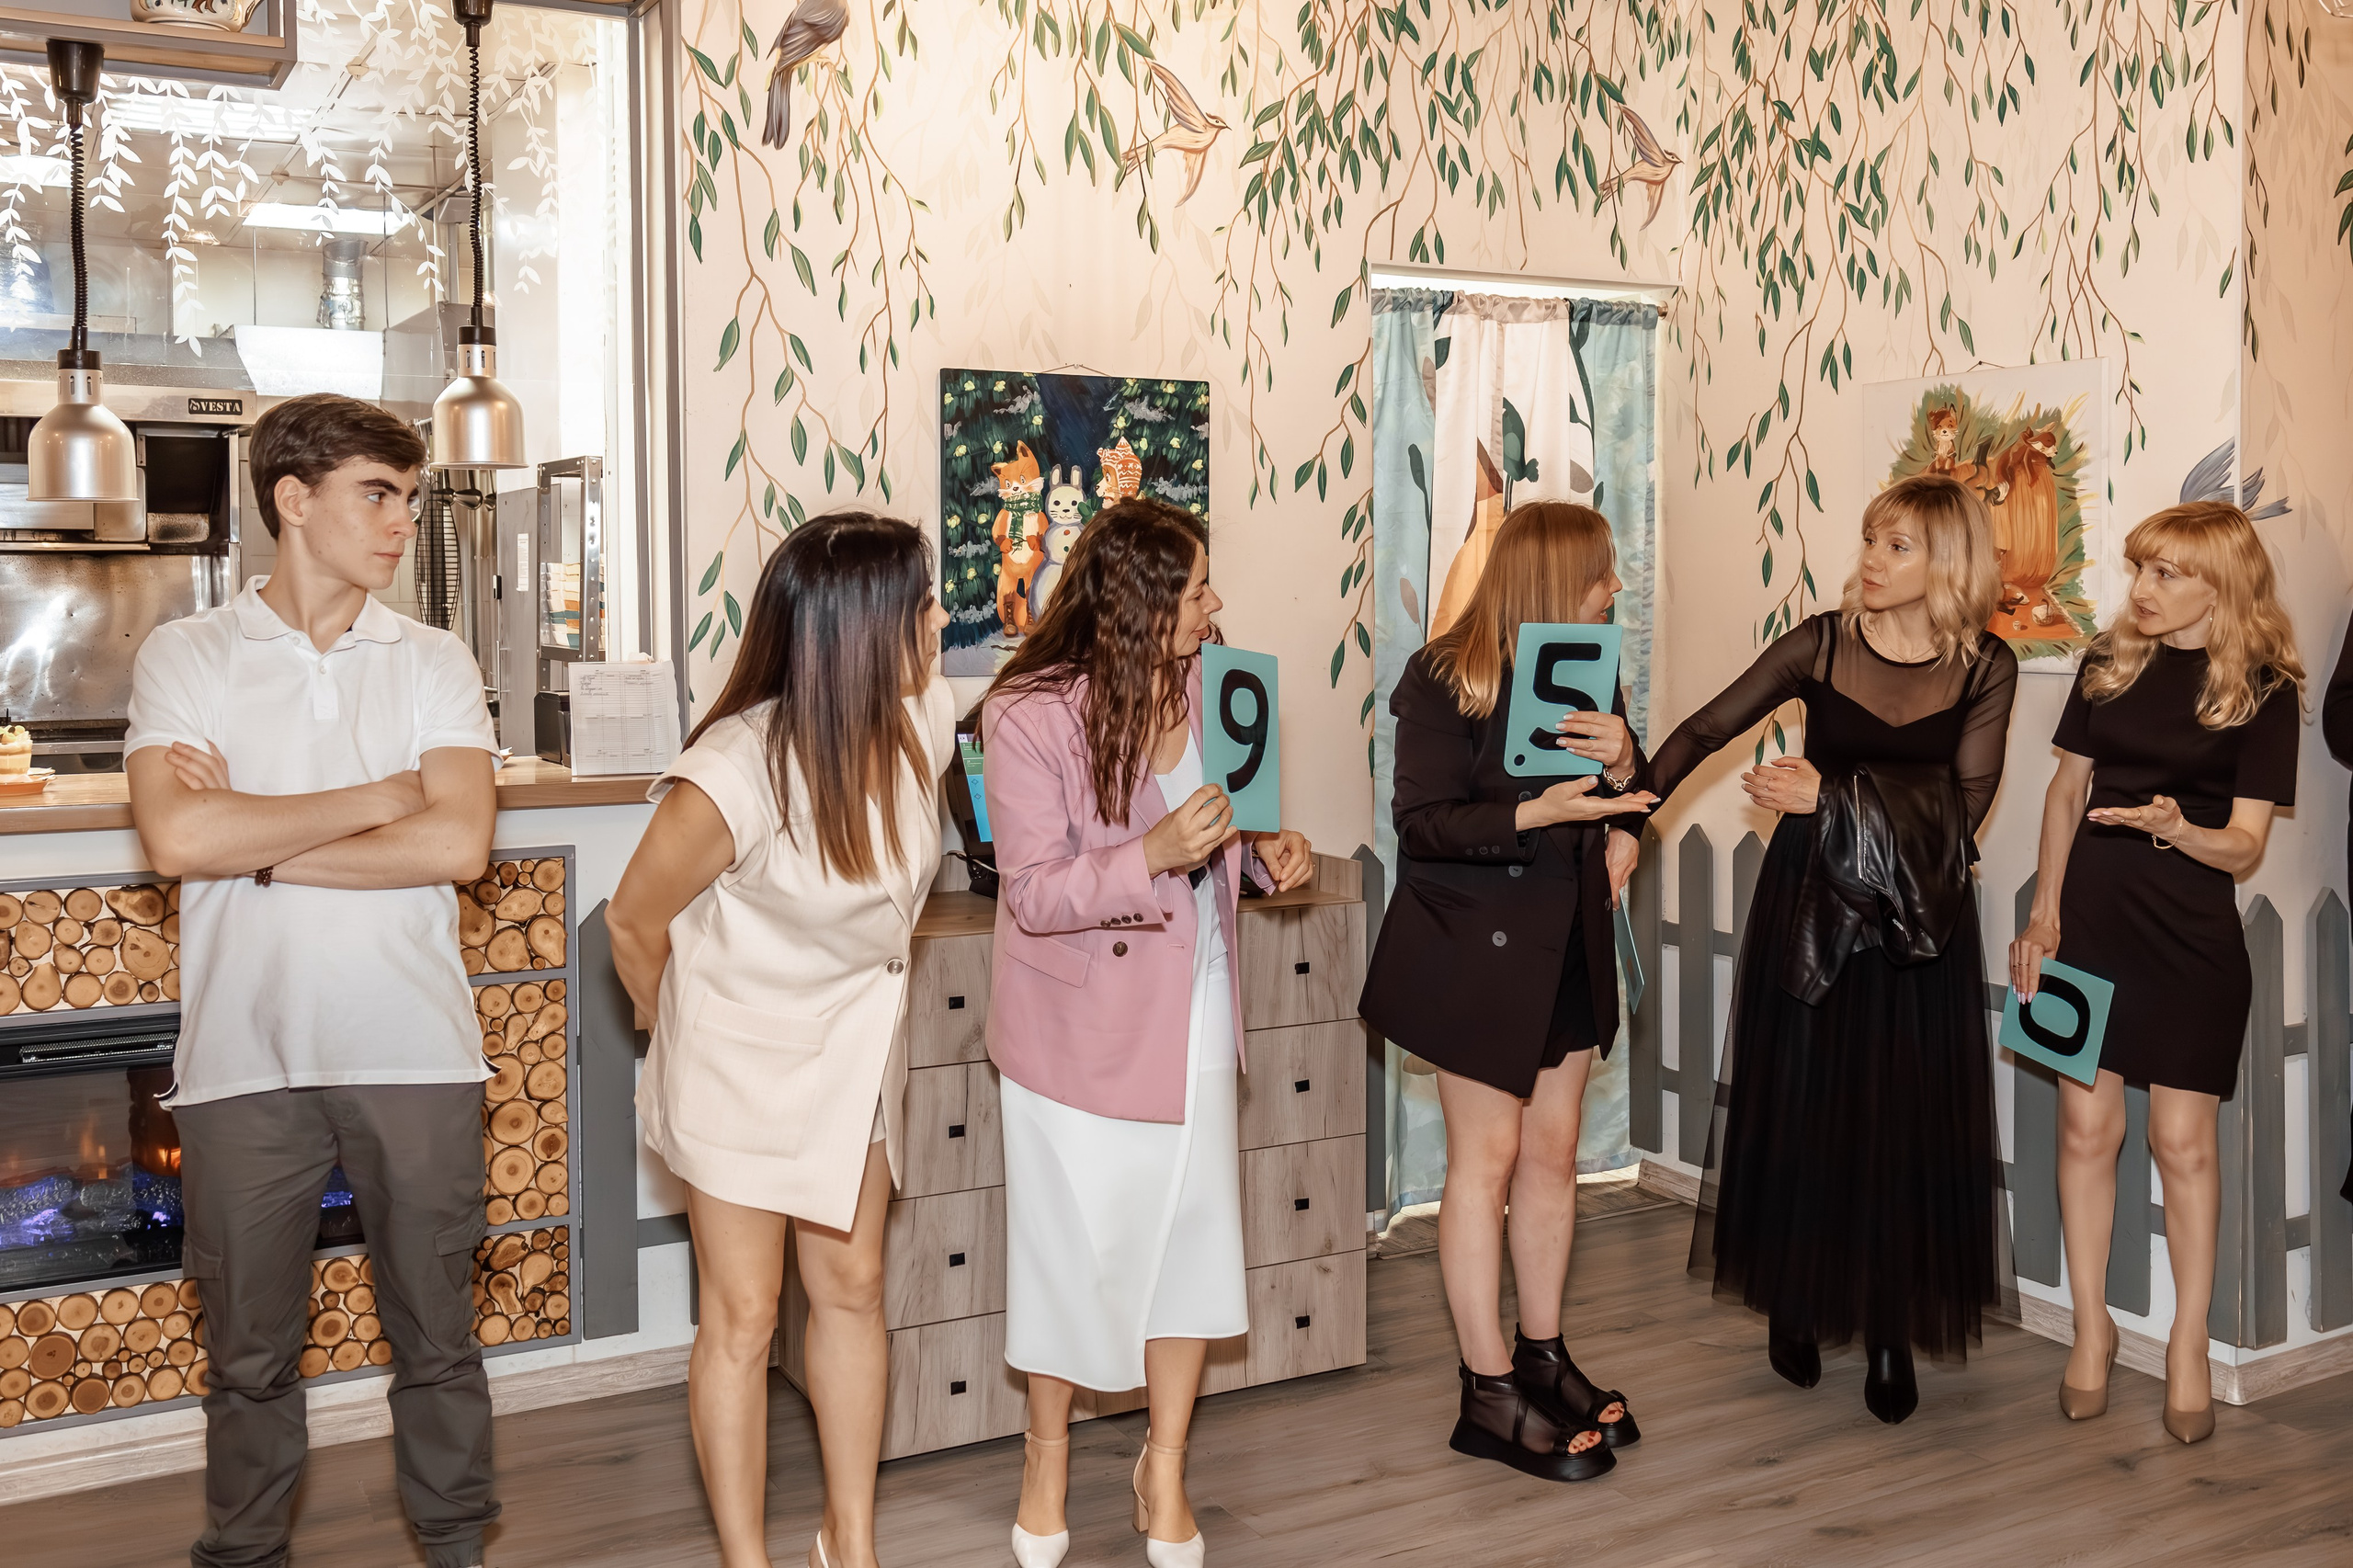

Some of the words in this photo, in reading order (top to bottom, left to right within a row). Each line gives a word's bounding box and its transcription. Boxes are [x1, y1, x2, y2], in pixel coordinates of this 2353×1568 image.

[200, 401, 241, 412] VESTA
[1220, 668, 1268, 793] 9
[1529, 642, 1602, 750] 5
